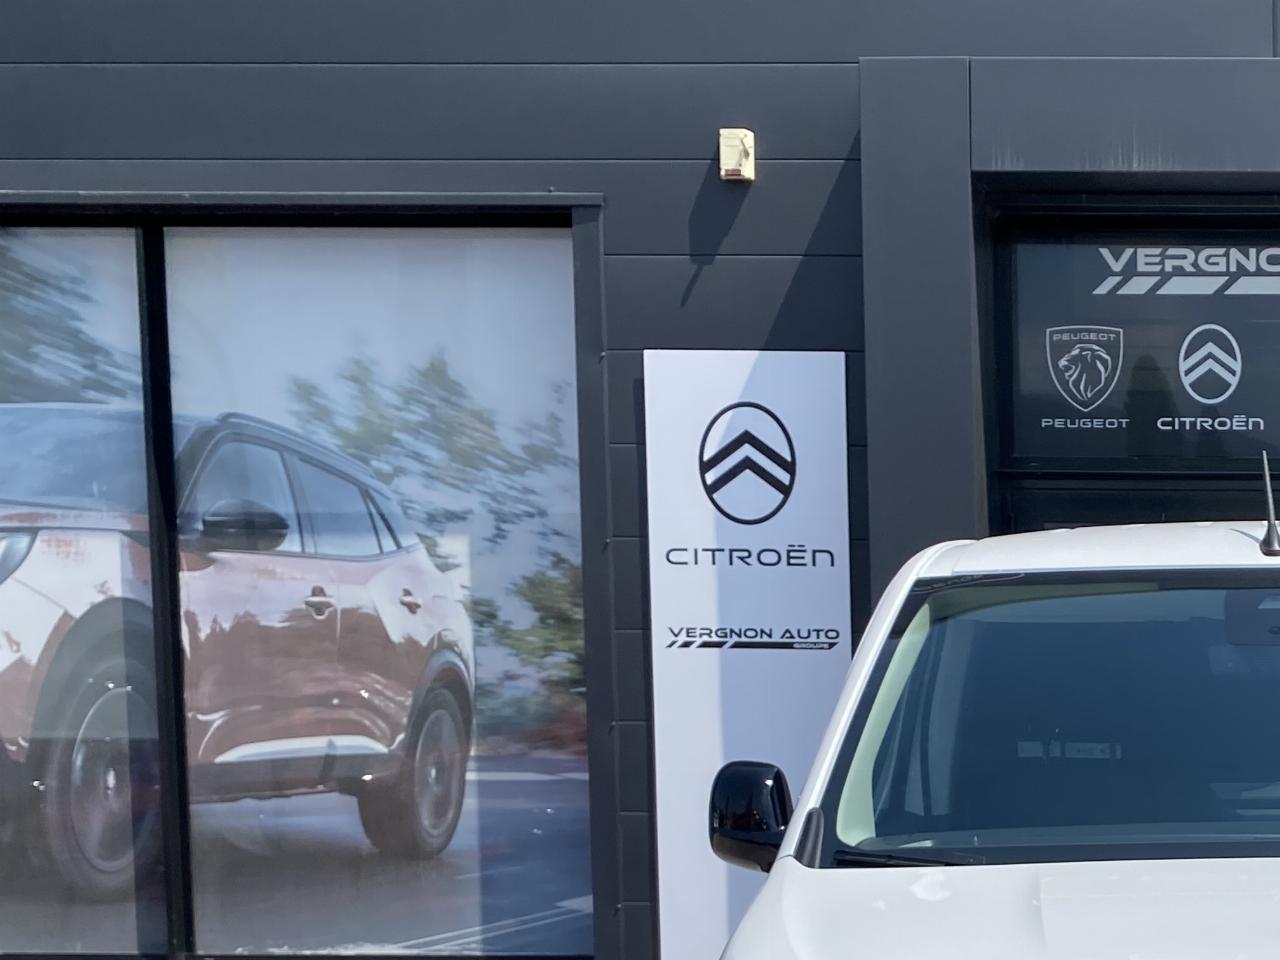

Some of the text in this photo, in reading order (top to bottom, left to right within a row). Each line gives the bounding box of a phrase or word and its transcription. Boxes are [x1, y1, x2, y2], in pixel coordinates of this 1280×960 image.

[1052, 331, 1117, 342] PEUGEOT
[1040, 417, 1131, 429] PEUGEOT
[668, 627, 840, 641] VERGNON AUTO
